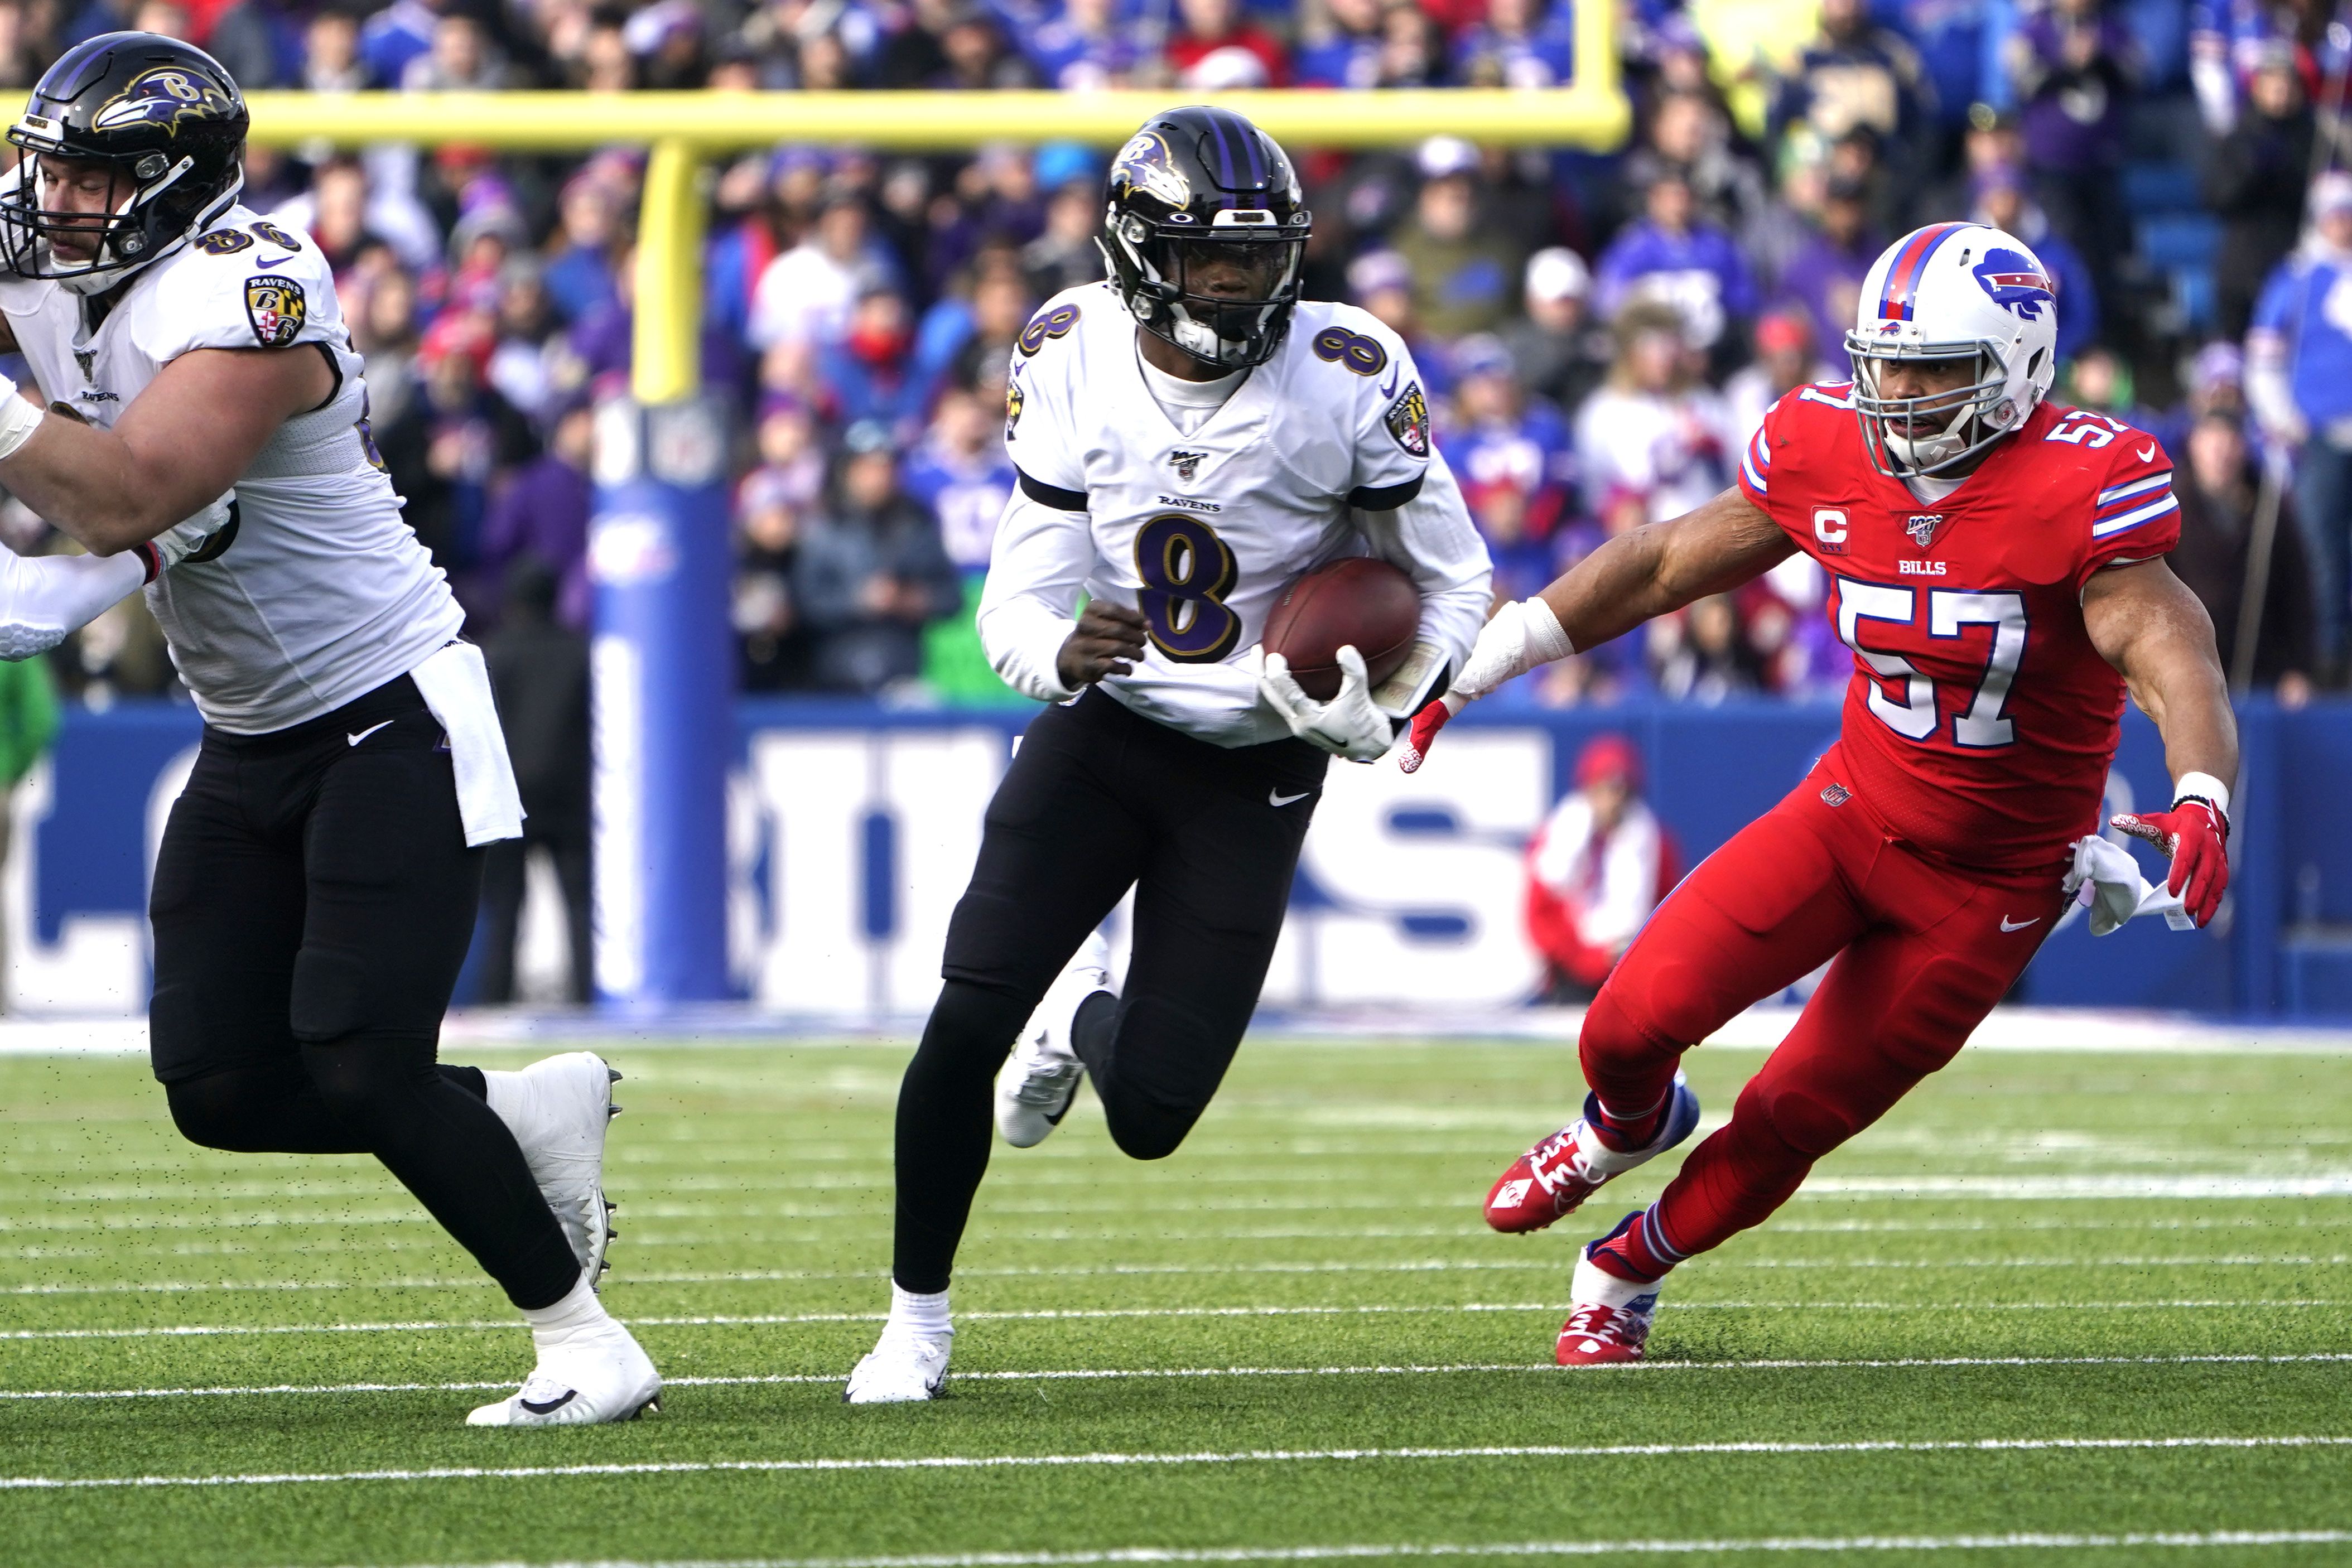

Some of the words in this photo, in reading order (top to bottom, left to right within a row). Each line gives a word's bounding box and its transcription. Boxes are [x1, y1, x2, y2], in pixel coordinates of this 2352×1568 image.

[194, 221, 302, 255] 86
[249, 278, 301, 295] RAVENS
[1019, 303, 1081, 358] 8
[1313, 326, 1387, 377] 8
[2043, 411, 2130, 449] 57
[1158, 496, 1221, 512] RAVENS
[1814, 510, 1848, 543] C
[1898, 560, 1948, 576] BILLS
[1134, 514, 1242, 664] 8
[1835, 573, 2030, 749] 57
